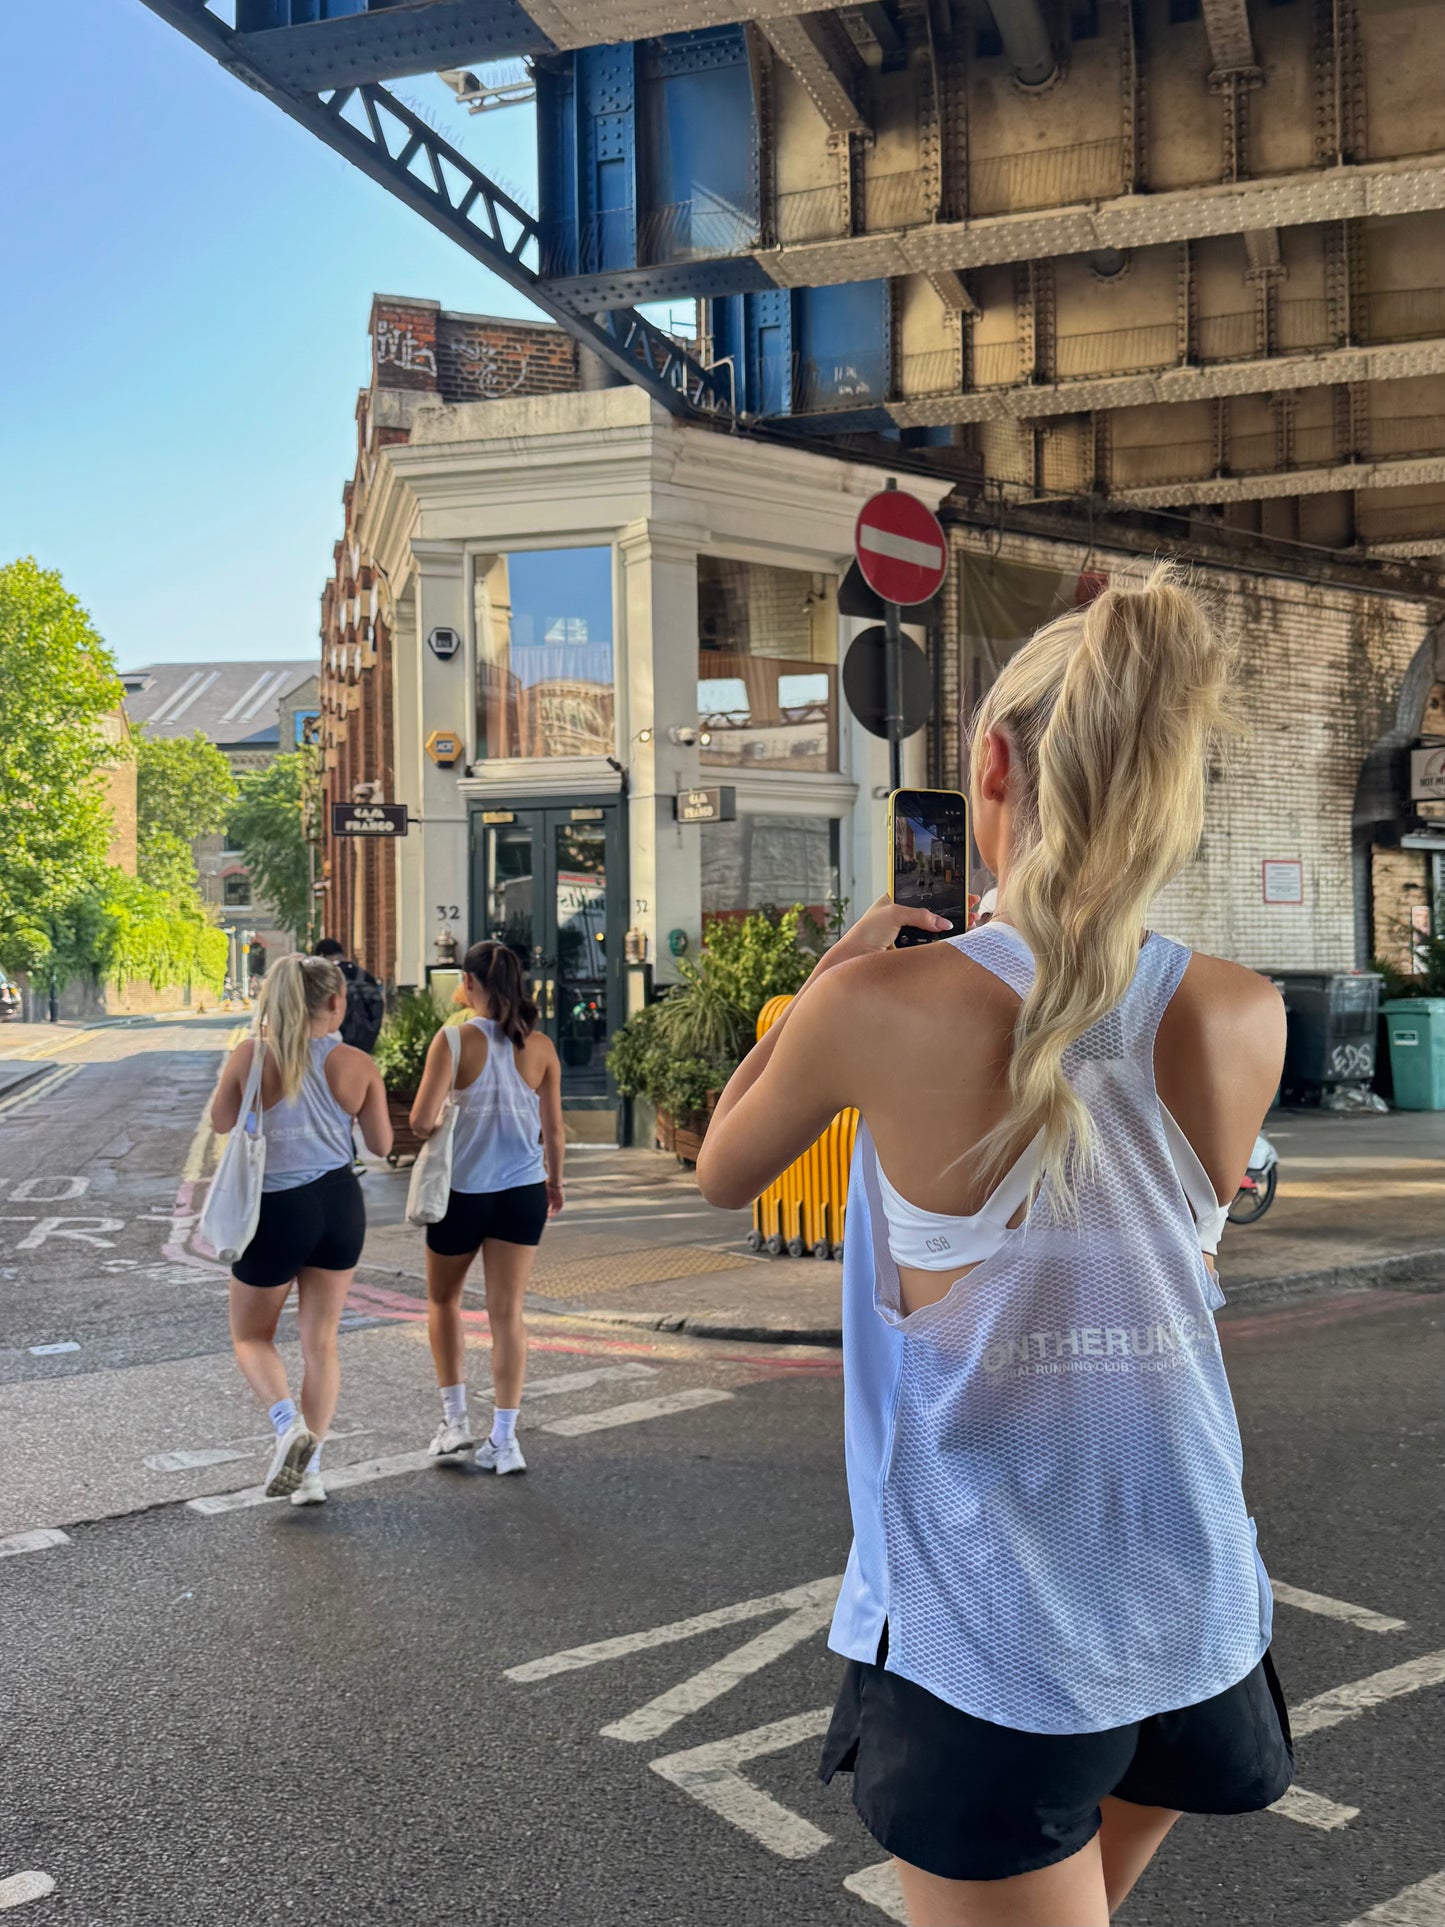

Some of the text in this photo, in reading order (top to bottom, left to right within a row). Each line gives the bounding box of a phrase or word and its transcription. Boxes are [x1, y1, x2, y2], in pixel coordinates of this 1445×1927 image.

[436, 905, 460, 921] 32
[635, 899, 648, 914] 32
[925, 1235, 951, 1253] CSB
[1035, 1361, 1093, 1376] RUNNING
[1093, 1360, 1130, 1374] CLUB
